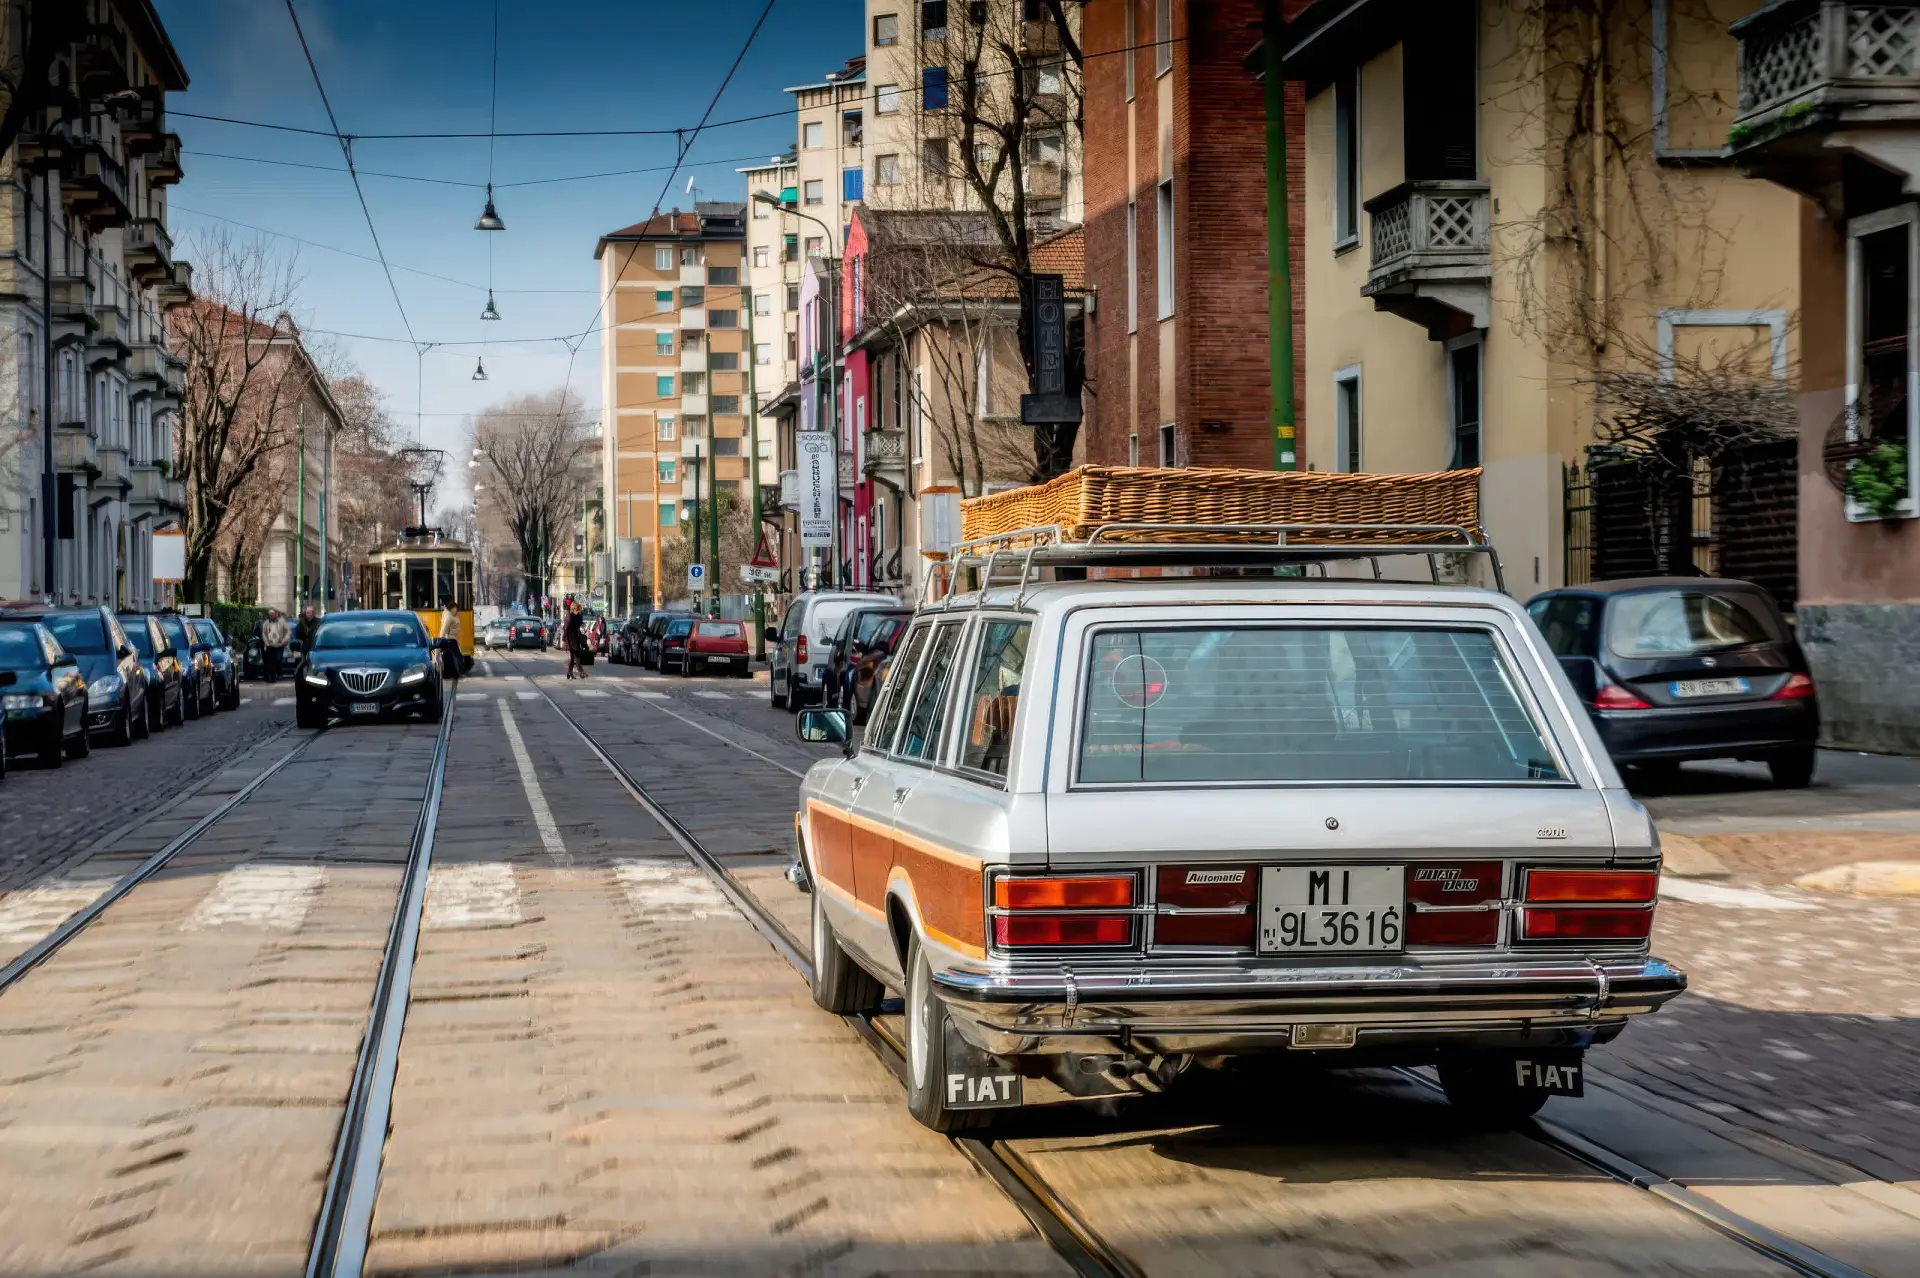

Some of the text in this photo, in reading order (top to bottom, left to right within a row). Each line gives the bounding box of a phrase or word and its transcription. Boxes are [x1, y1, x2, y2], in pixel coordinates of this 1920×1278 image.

[1038, 279, 1061, 392] HOTEL
[1187, 873, 1243, 883] Automatic
[1416, 869, 1459, 880] FIAT
[1280, 910, 1399, 947] 9L3616
[947, 1074, 1016, 1103] FIAT
[1515, 1060, 1578, 1090] FIAT
